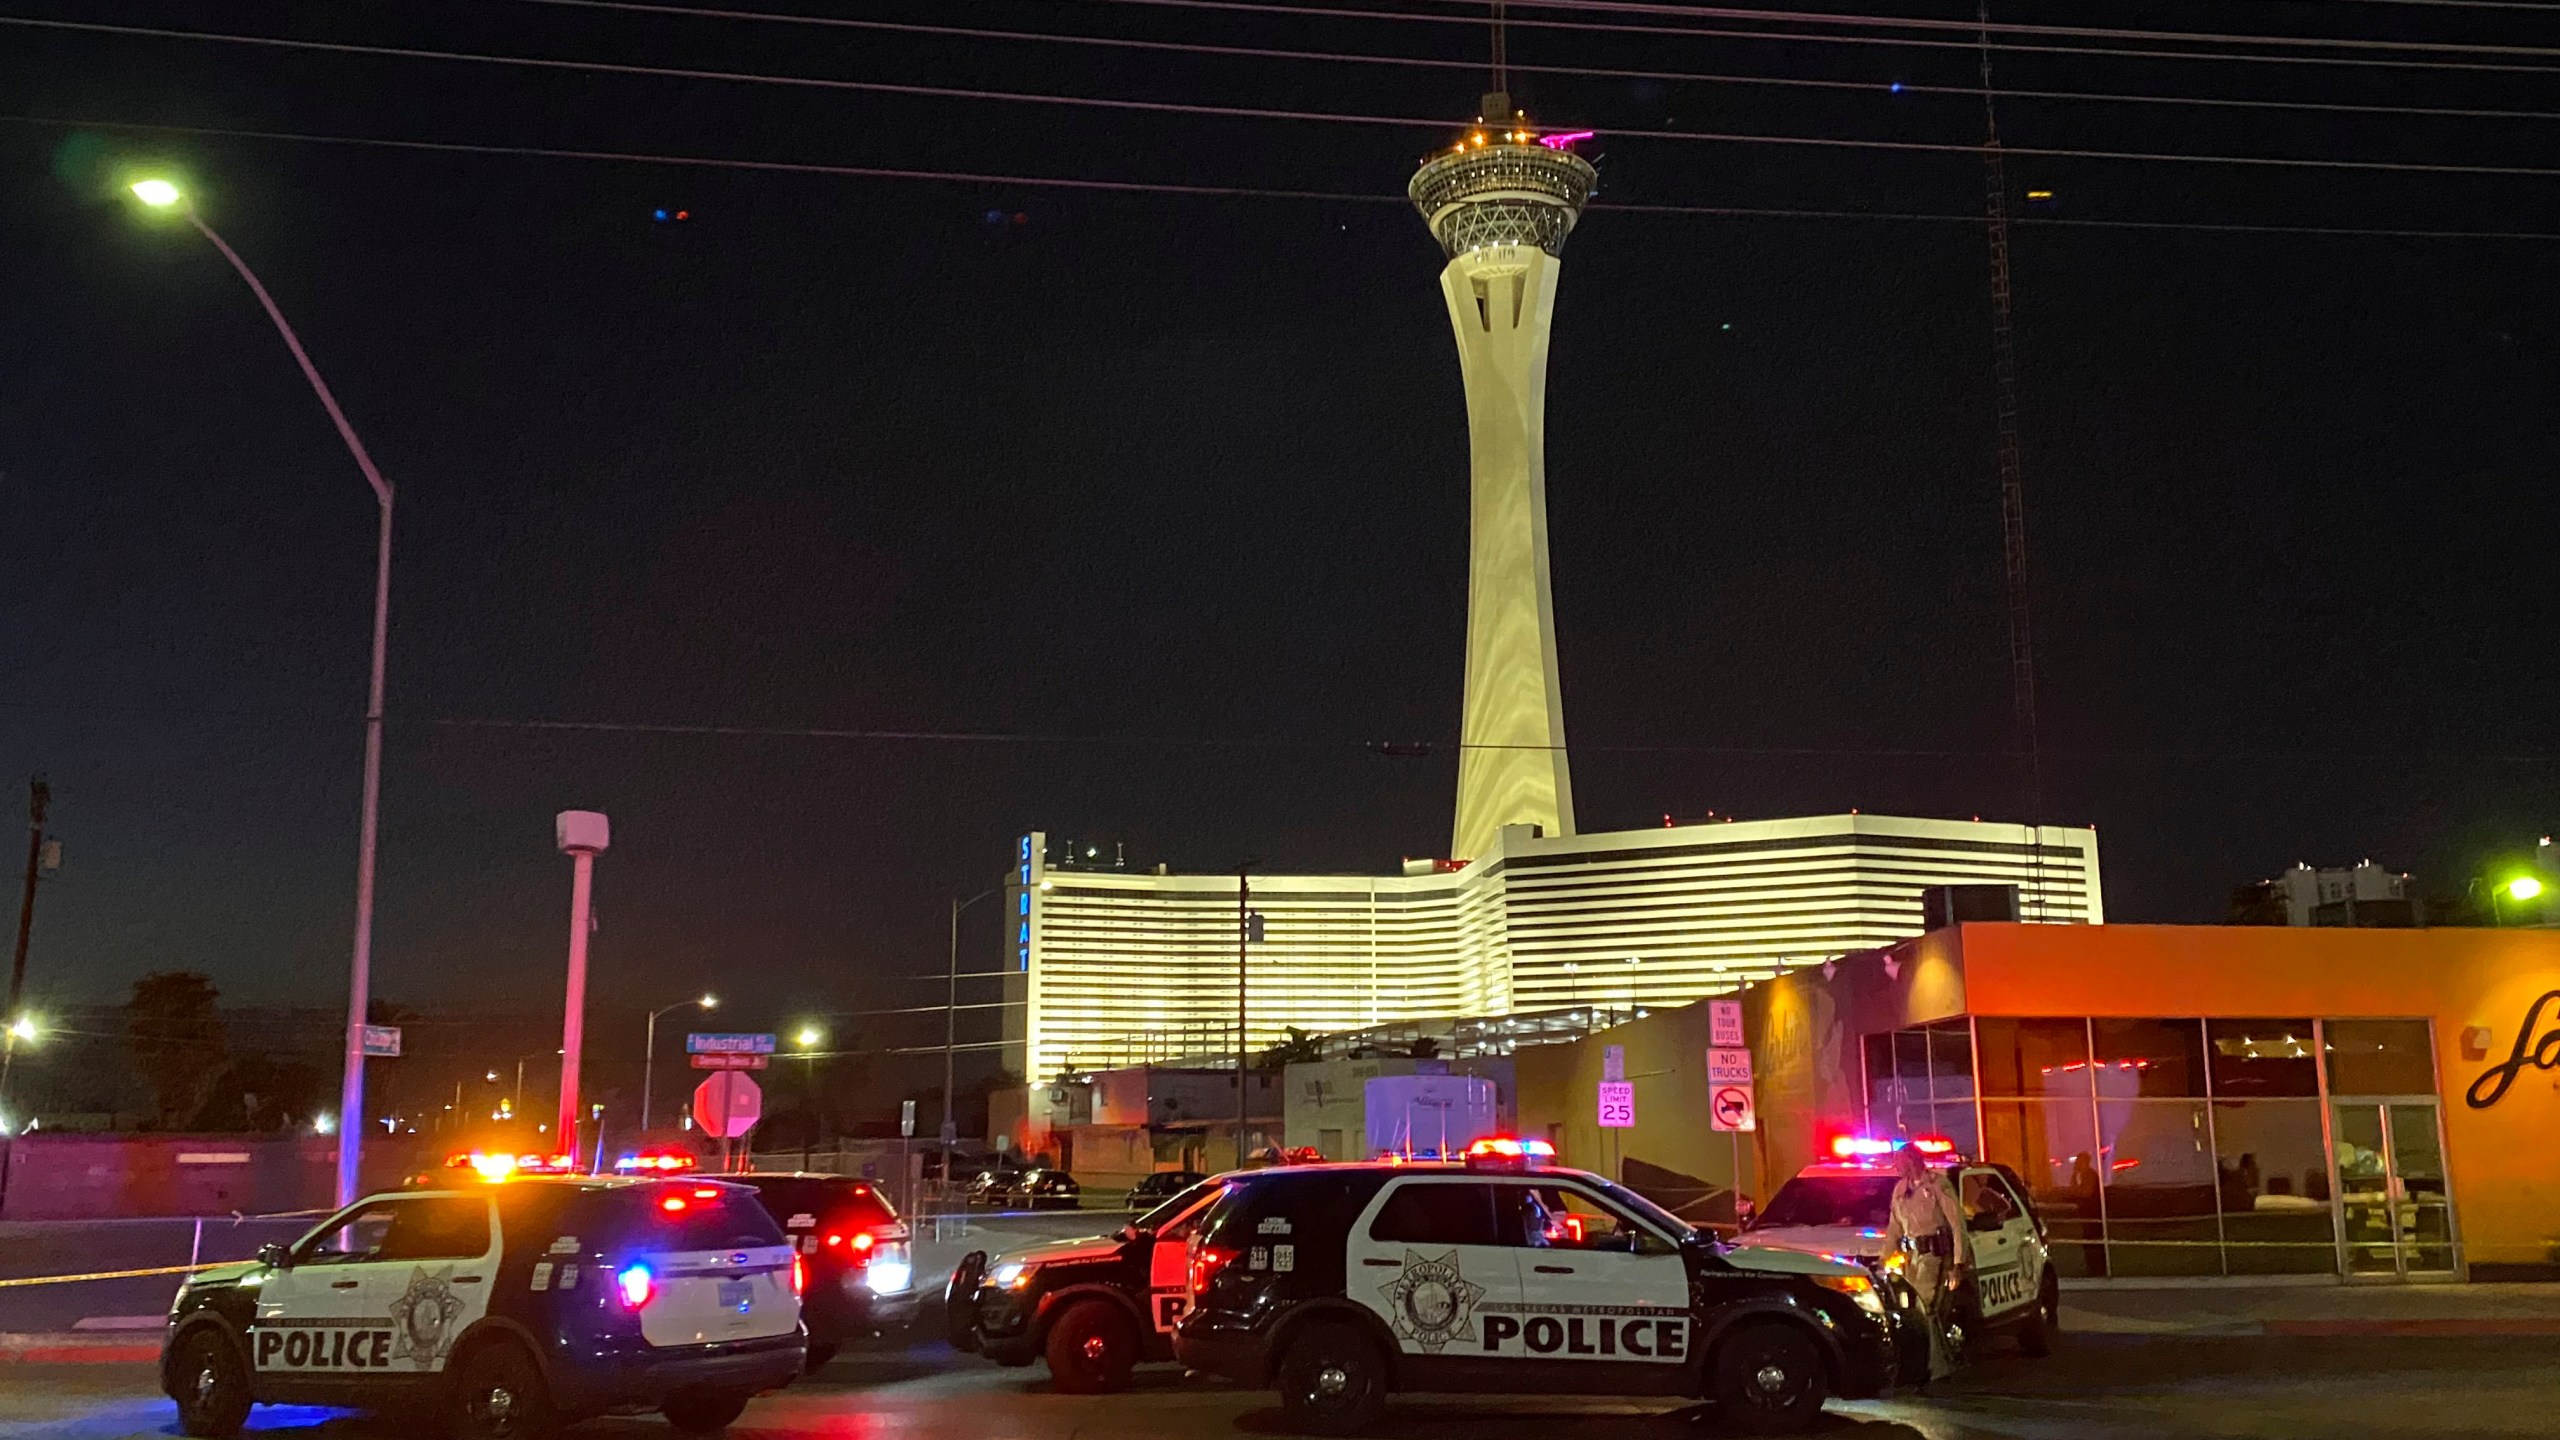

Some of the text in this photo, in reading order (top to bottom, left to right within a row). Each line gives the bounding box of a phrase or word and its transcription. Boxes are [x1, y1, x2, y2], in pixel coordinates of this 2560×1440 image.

[1019, 836, 1031, 972] STRAT
[1720, 1006, 1731, 1015] NO
[1717, 1018, 1736, 1028] TOUR
[1715, 1030, 1739, 1041] BUSES
[695, 1035, 754, 1051] Industrial
[1721, 1053, 1737, 1065] NO
[1711, 1067, 1749, 1078] TRUCKS
[1602, 1087, 1631, 1095] SPEED
[1605, 1095, 1627, 1103] LIMIT
[1603, 1104, 1631, 1121] 25
[1981, 1271, 2022, 1309] POLICE
[1524, 1304, 1566, 1314] VEGAS
[1572, 1306, 1676, 1316] METROPOLITAN
[1483, 1315, 1685, 1357] POLICE
[258, 1331, 392, 1367] POLICE
